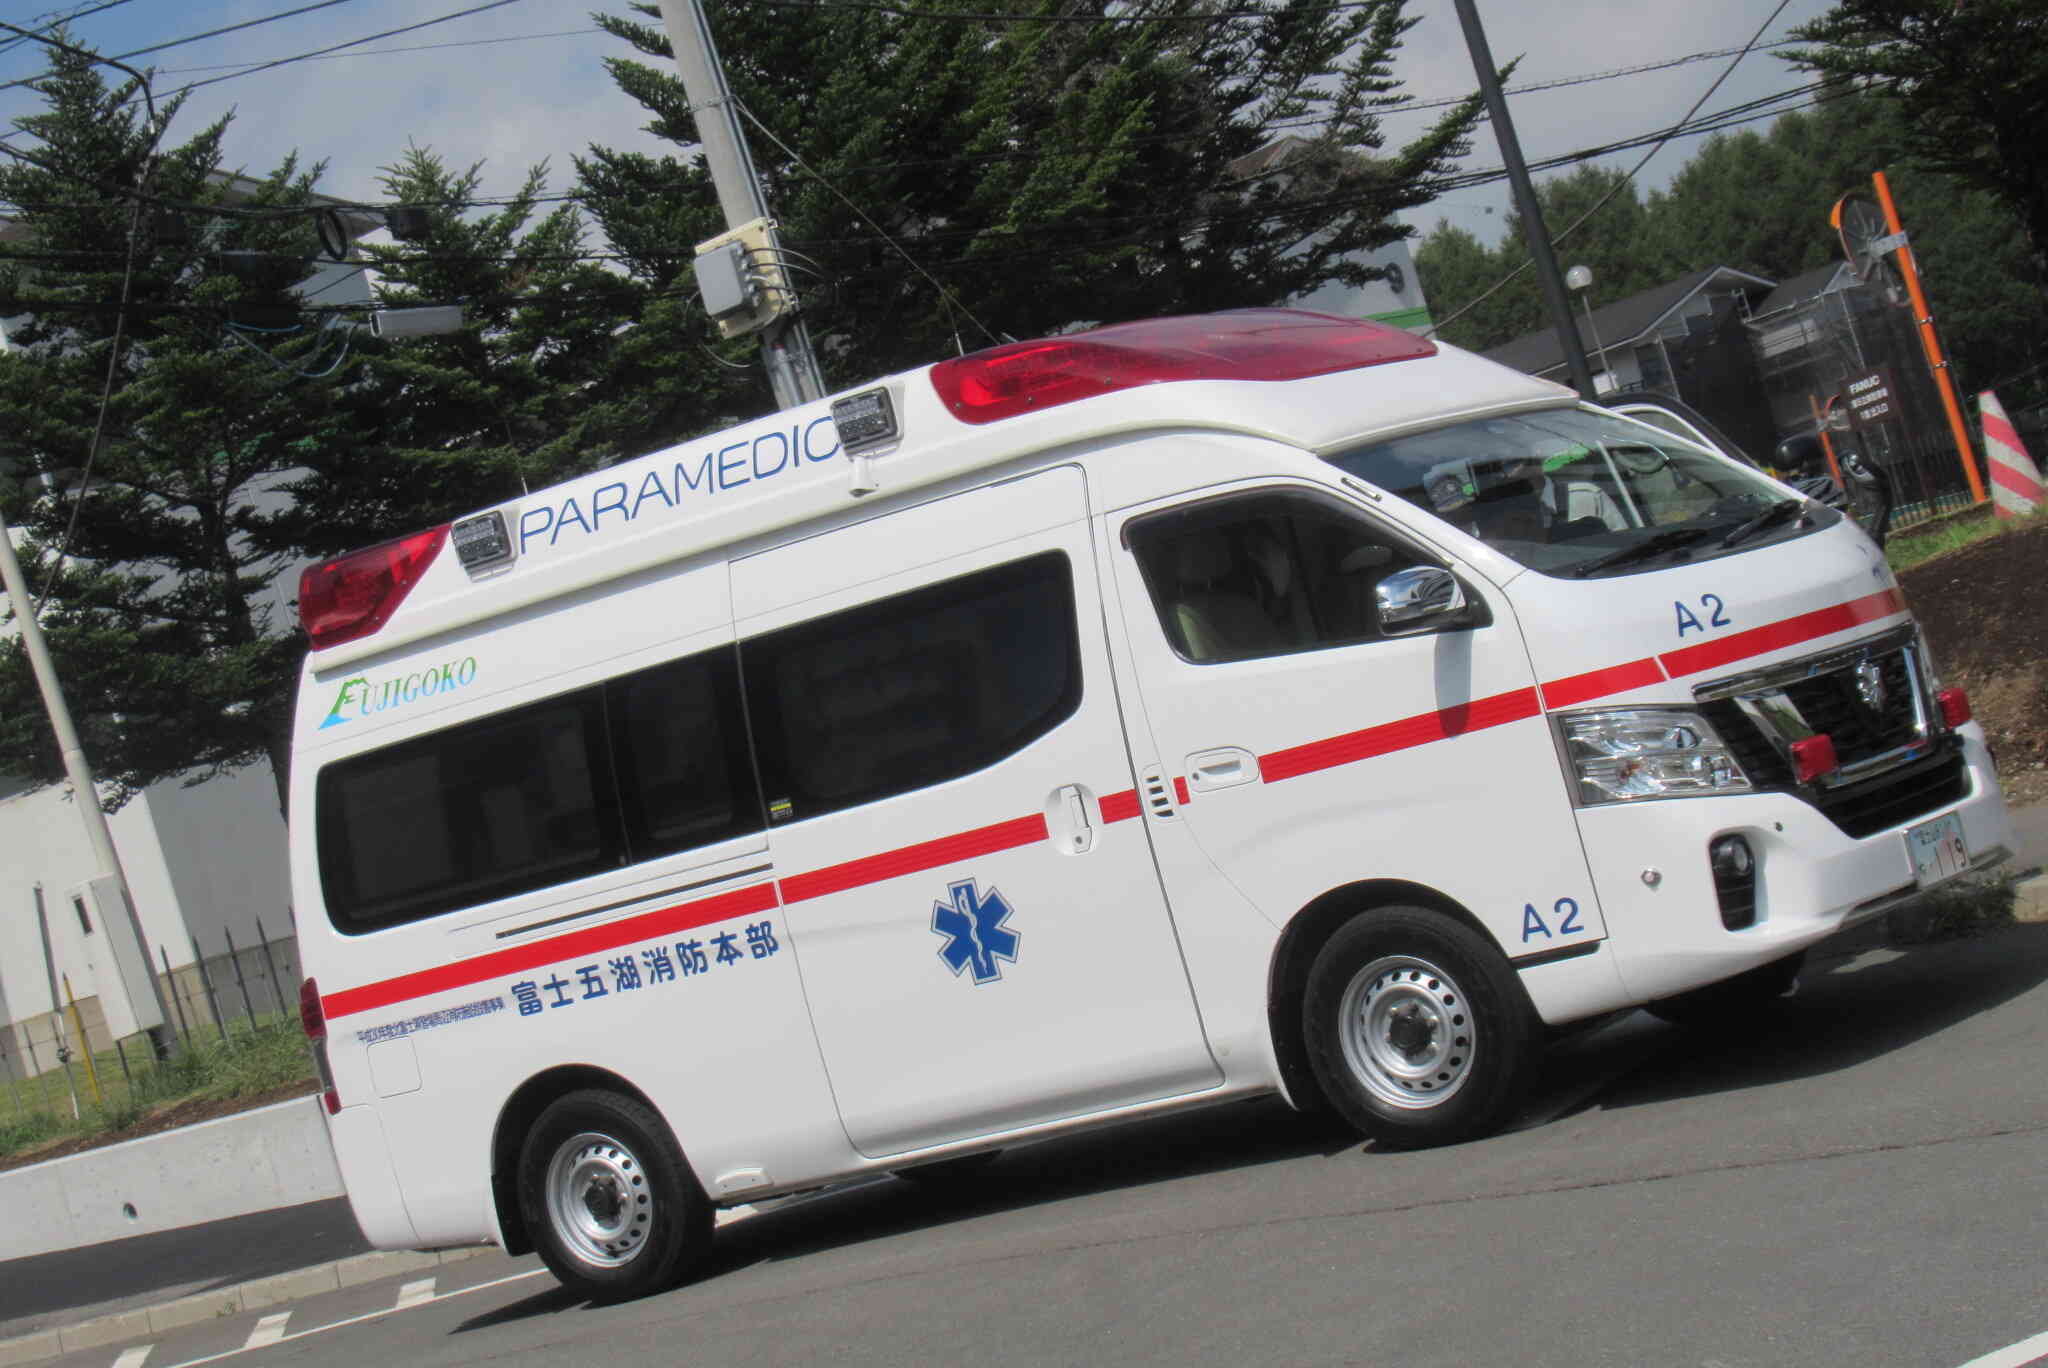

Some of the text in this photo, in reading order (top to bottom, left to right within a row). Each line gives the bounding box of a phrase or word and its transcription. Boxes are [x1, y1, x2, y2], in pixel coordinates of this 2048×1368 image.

[520, 415, 840, 555] PARAMEDIC
[1674, 593, 1731, 638] A2
[317, 656, 477, 731] FUJIGOKO
[1522, 897, 1585, 943] A2
[510, 920, 780, 1017] 富士五湖消防本部
